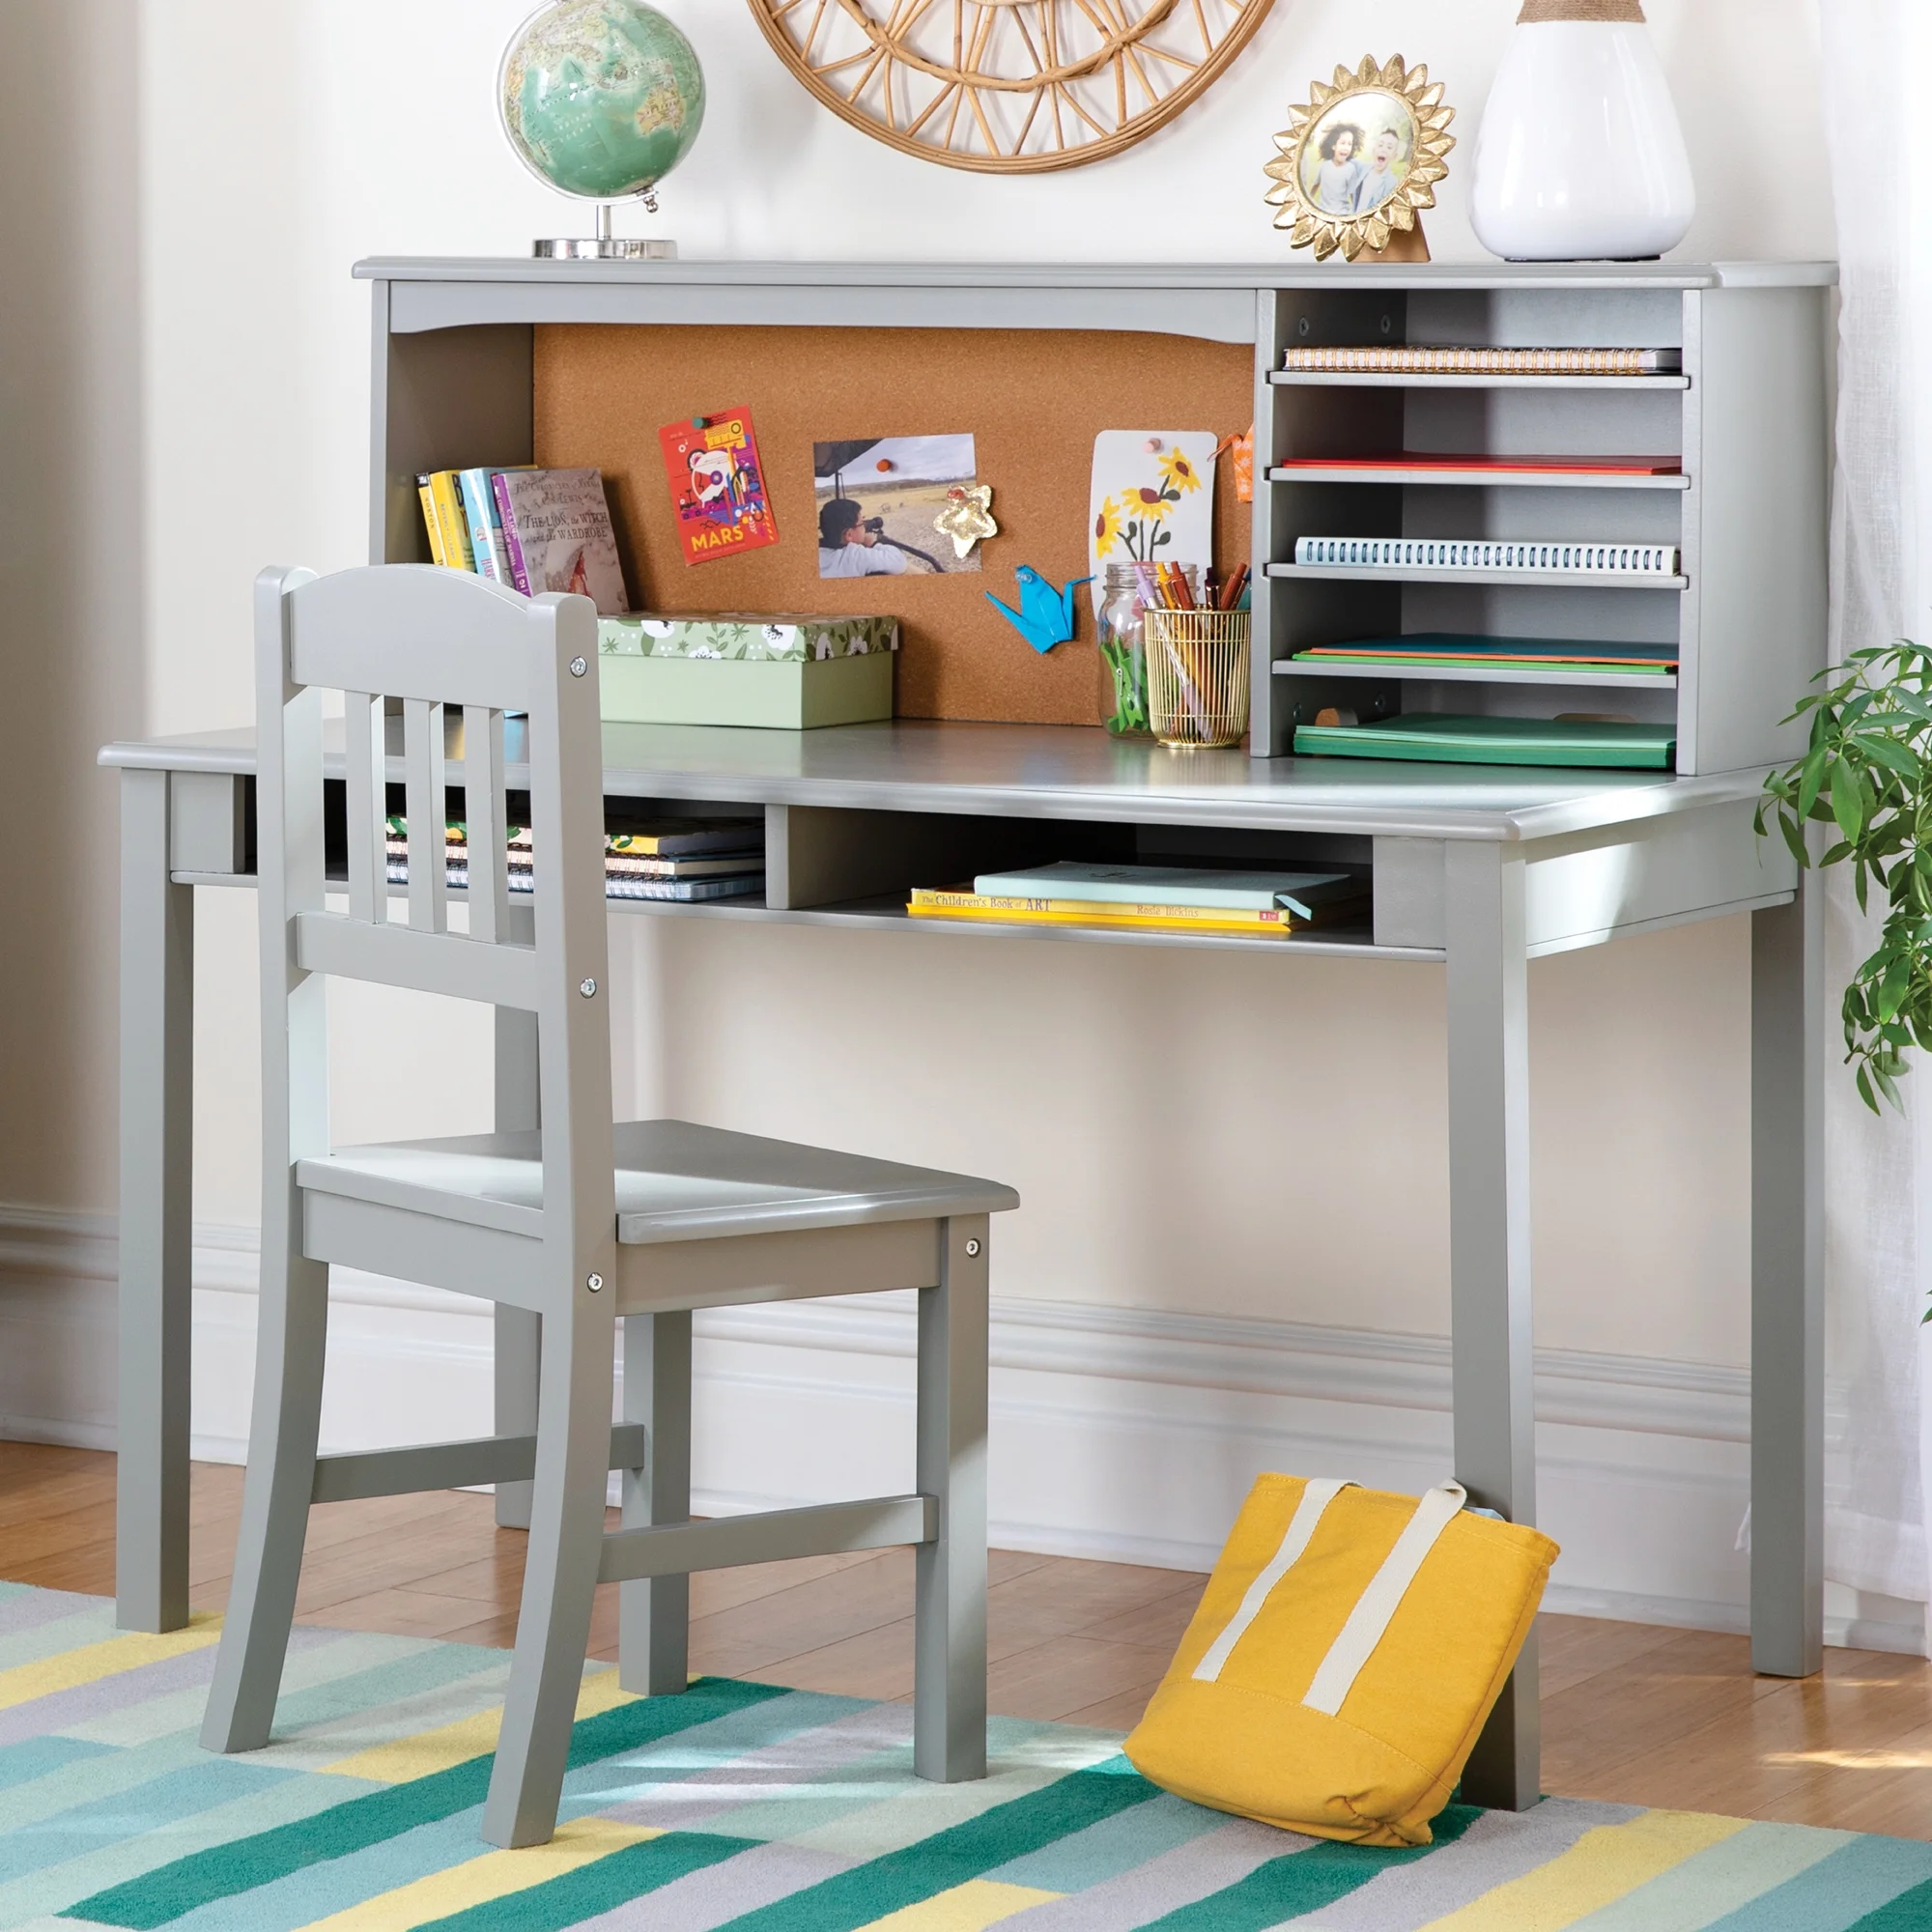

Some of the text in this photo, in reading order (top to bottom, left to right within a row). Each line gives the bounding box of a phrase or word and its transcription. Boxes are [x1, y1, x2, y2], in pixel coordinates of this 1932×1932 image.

[580, 512, 608, 525] WITCH
[557, 526, 608, 539] WARDROBE
[691, 526, 744, 552] MARS
[935, 895, 986, 907] Children's
[990, 897, 1013, 909] Book
[1025, 898, 1053, 912] ART
[1137, 904, 1199, 918] Rosie Dickins
